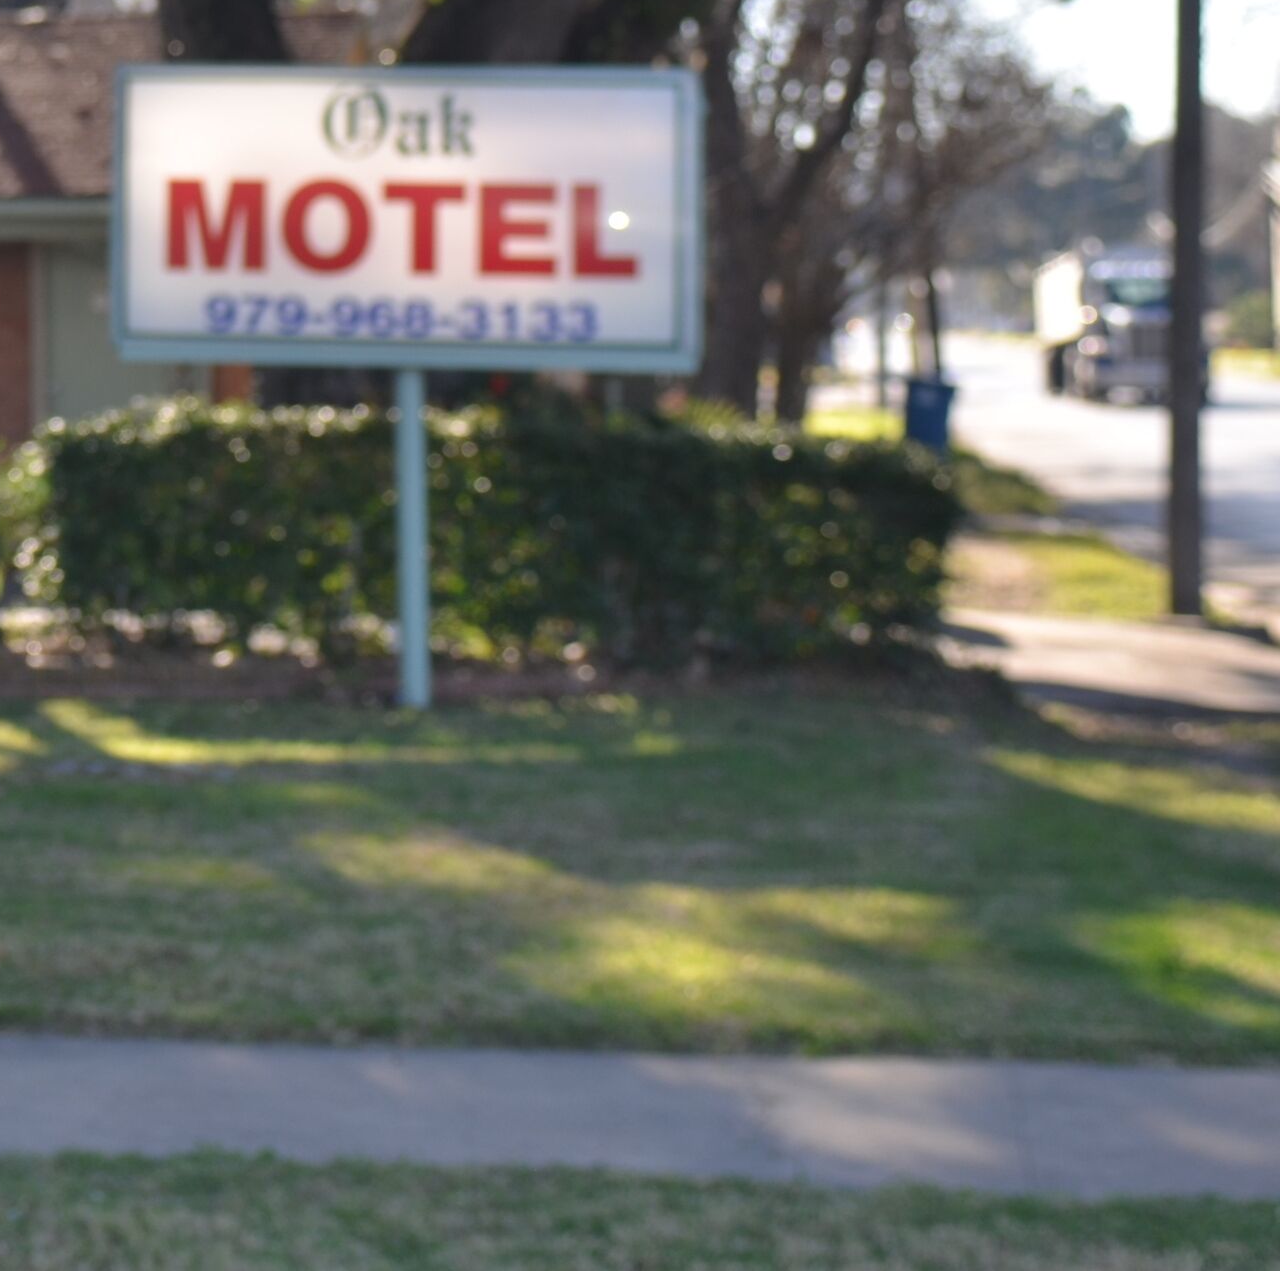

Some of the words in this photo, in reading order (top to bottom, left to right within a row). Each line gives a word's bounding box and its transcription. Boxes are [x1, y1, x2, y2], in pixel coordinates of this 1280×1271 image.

[323, 86, 475, 157] Oak
[167, 180, 639, 278] MOTEL
[205, 295, 599, 342] 979-968-3133
